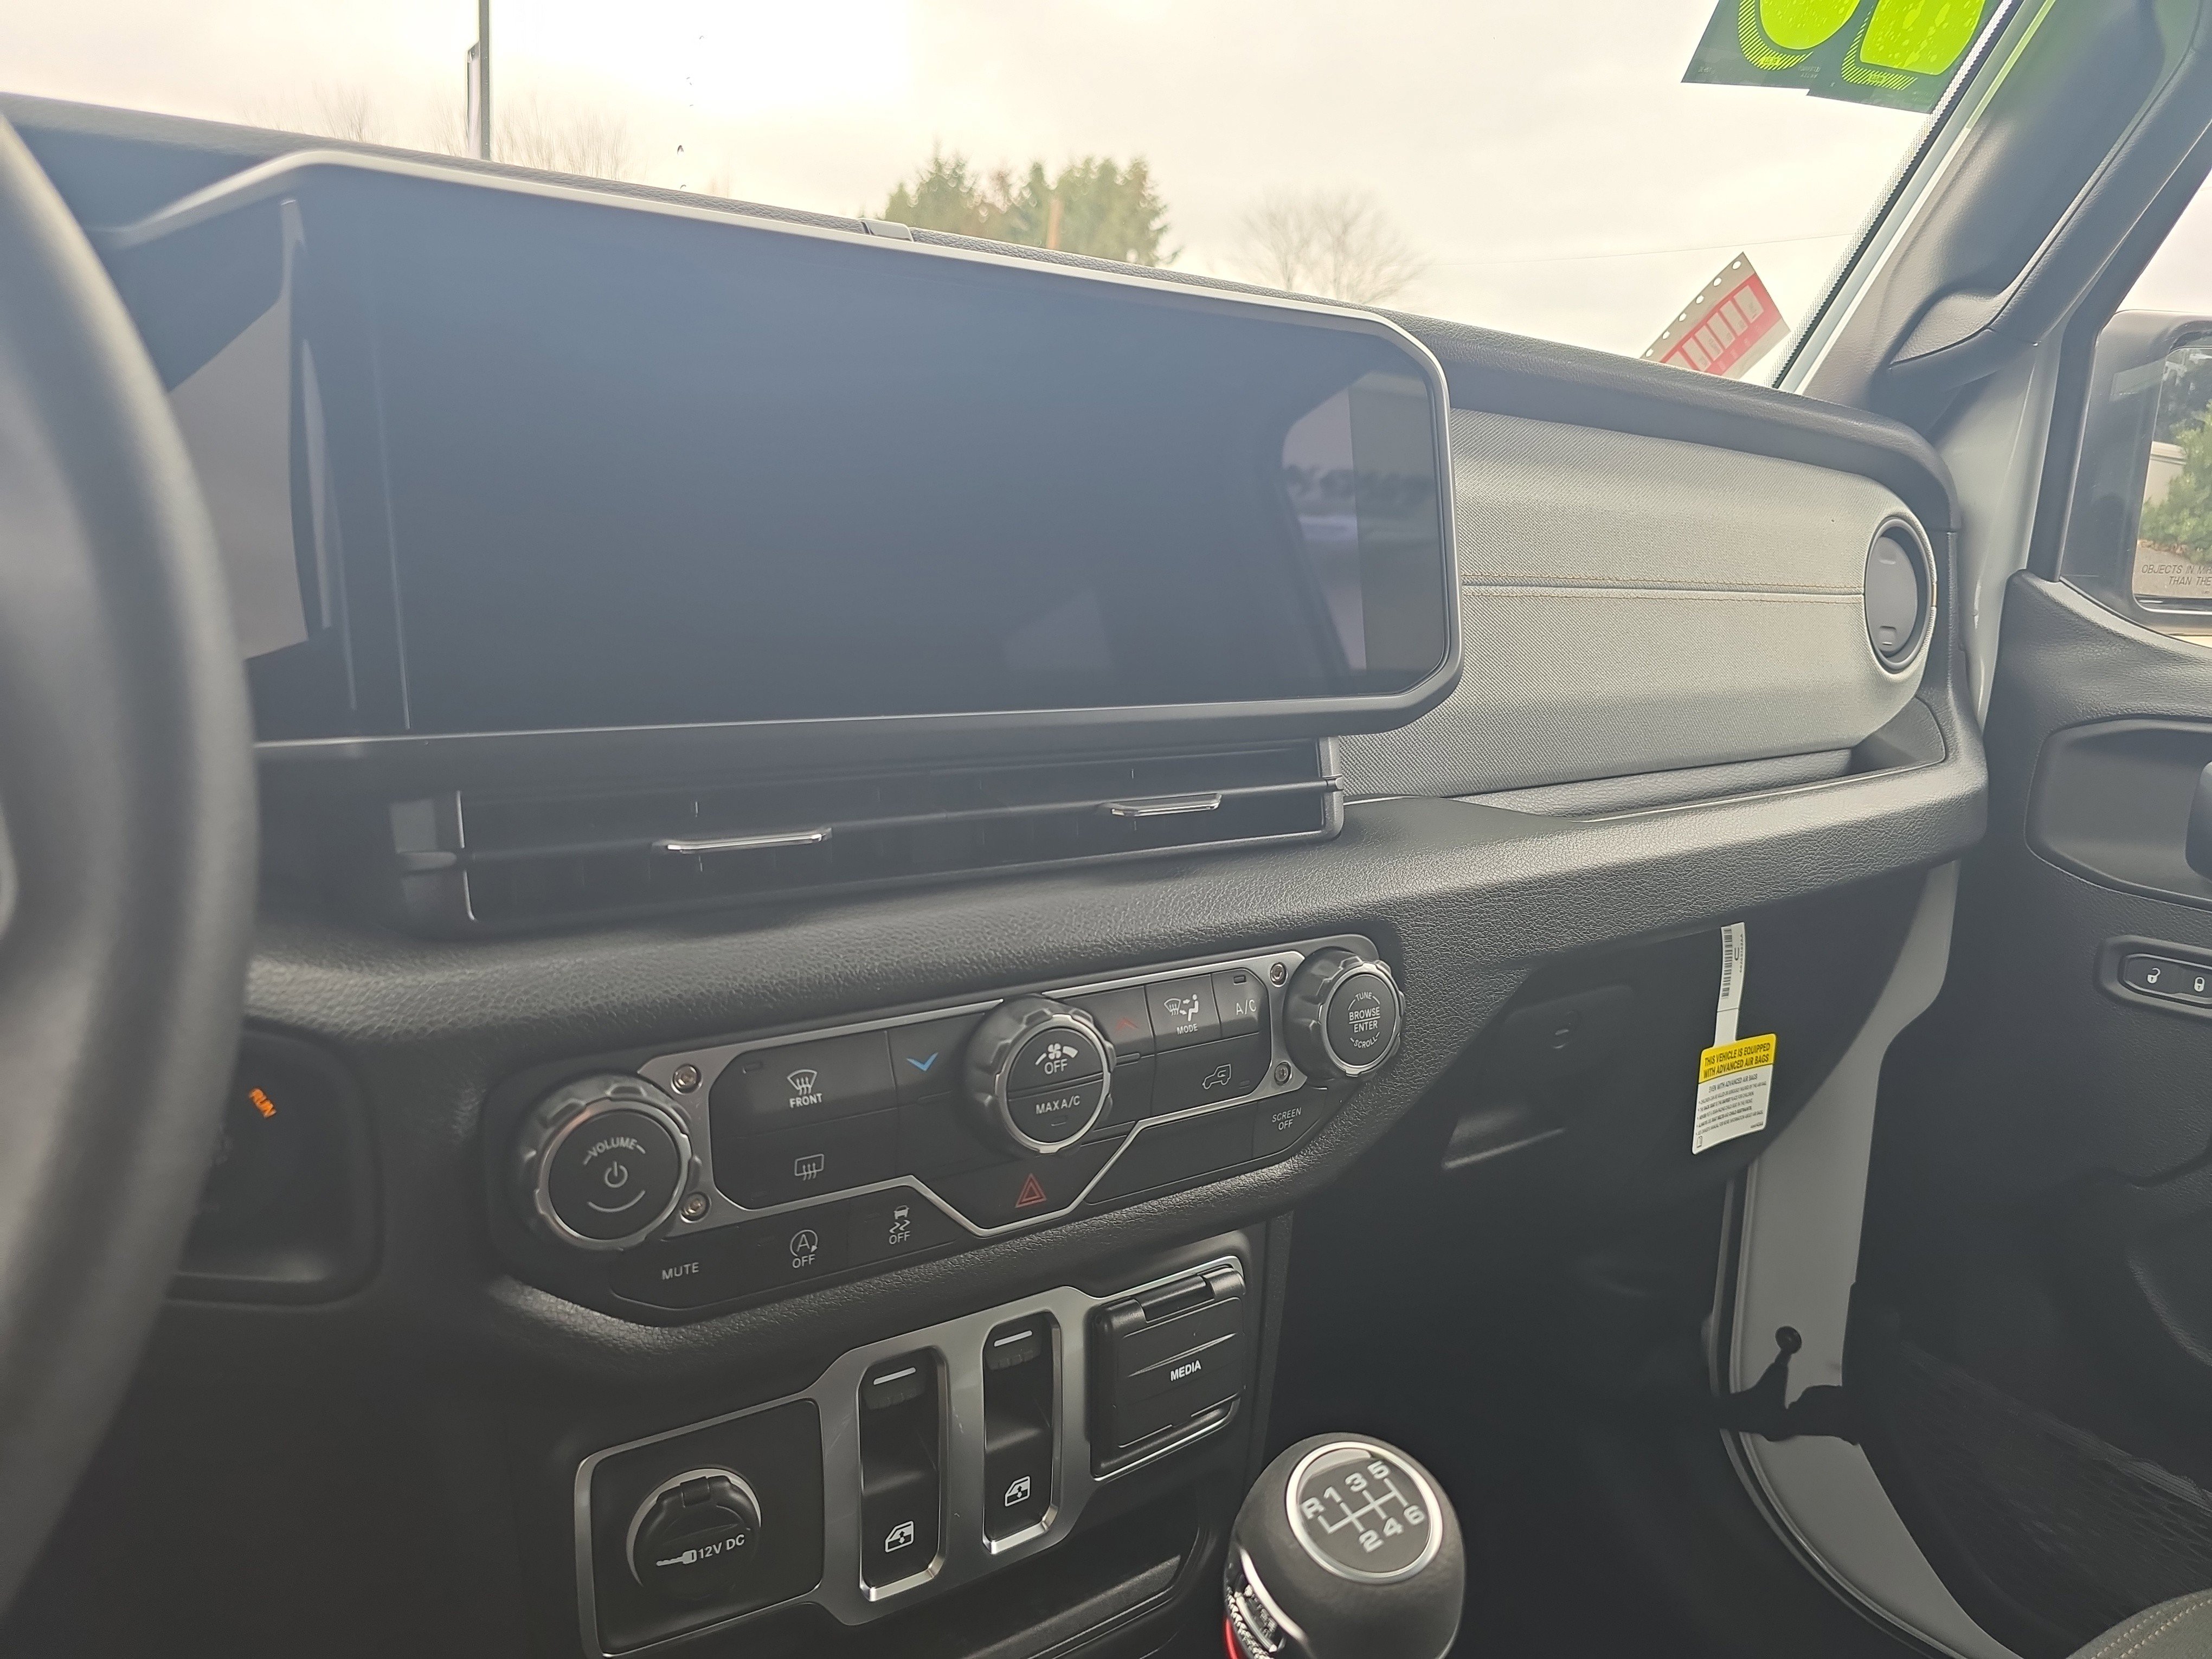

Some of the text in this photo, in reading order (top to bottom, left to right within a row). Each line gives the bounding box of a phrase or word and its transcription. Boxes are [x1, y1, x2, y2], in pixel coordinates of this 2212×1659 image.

[2141, 564, 2183, 574] OBJECTS
[2185, 564, 2193, 574] IN
[2169, 576, 2191, 585] THAN
[1355, 992, 1372, 1001] TUNE
[1236, 999, 1256, 1015] A/C
[1349, 1007, 1380, 1021] BROWSE
[1176, 1024, 1198, 1035] MODE
[1354, 1020, 1378, 1033] ENTER
[1354, 1036, 1378, 1049] SCROLL
[1705, 1043, 1770, 1066] THIS VEHICLE IS EQUIPPED
[1044, 1058, 1068, 1075] OFF
[1703, 1053, 1769, 1079] WITH ADVANCED AIR BAGS
[249, 1088, 277, 1118] RUN
[789, 1093, 822, 1109] FRONT
[1036, 1095, 1081, 1115] MAX A/C
[1272, 1107, 1301, 1123] SCREEN
[1278, 1119, 1293, 1130] OFF
[588, 1136, 638, 1157] VOLUME
[889, 1231, 911, 1245] OFF
[792, 1254, 815, 1269] OFF
[662, 1262, 699, 1281] MUTE
[1171, 1360, 1202, 1381] MEDIA
[1301, 1461, 1391, 1520] R 1 3 5
[1359, 1505, 1426, 1553] 2 4 6
[698, 1534, 745, 1559] 12V DC
